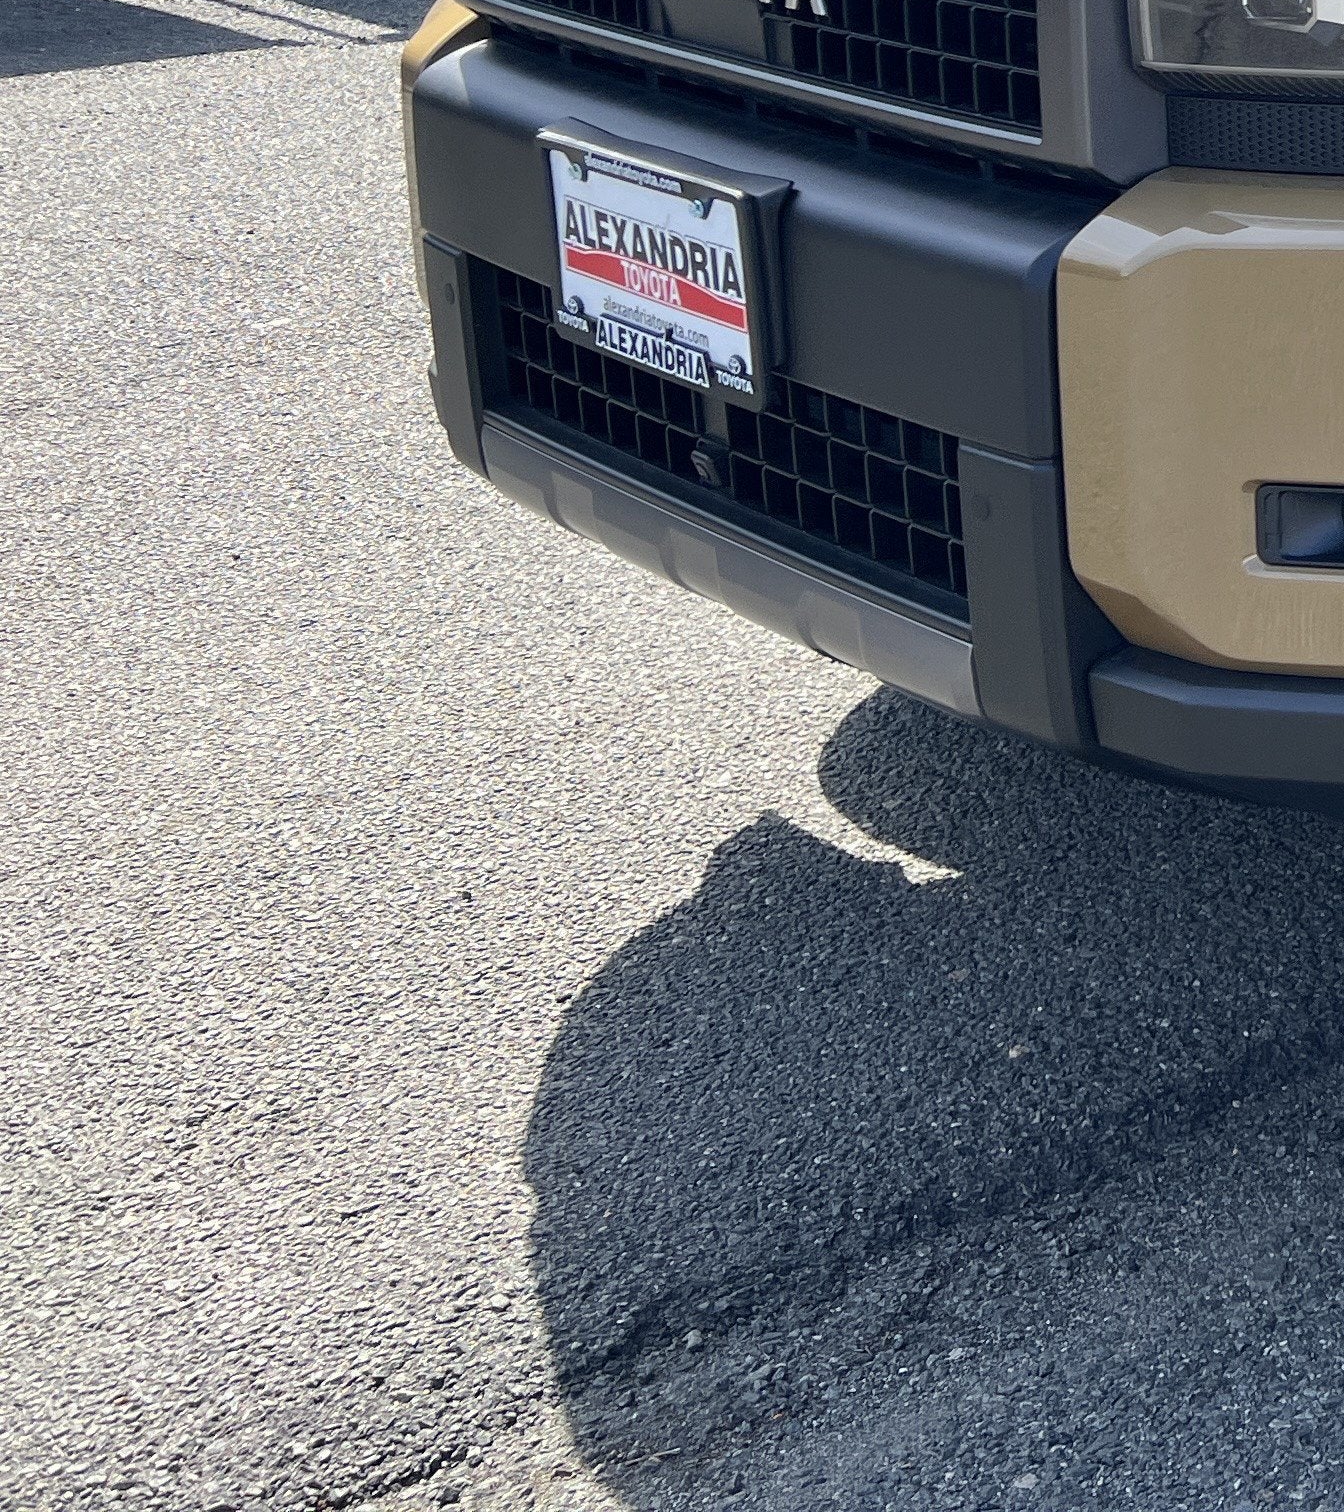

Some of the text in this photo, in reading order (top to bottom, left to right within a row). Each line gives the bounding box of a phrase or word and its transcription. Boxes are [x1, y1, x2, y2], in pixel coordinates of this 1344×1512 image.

[564, 198, 745, 302] ALEXANDRIA
[621, 259, 683, 307] TOYOTA
[557, 310, 590, 333] TOYOTA
[596, 317, 710, 388] ALEXANDRIA
[715, 369, 754, 395] TOYOTA
